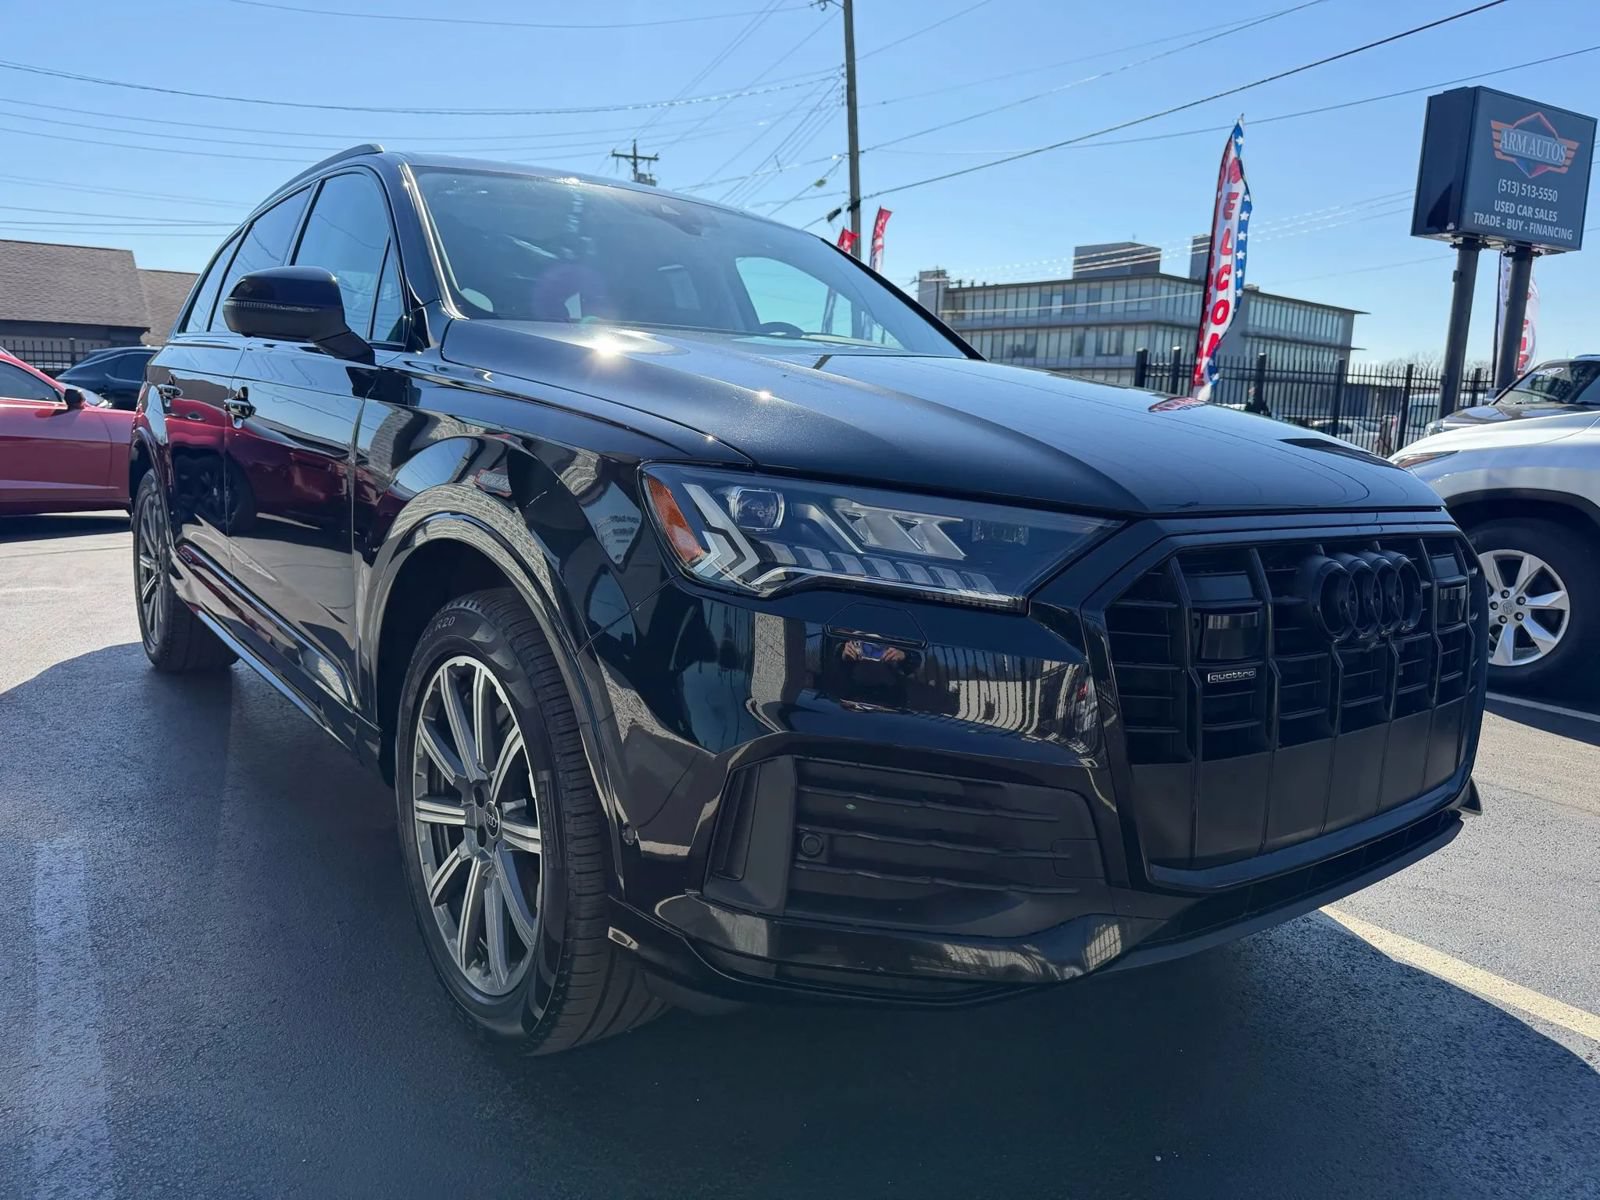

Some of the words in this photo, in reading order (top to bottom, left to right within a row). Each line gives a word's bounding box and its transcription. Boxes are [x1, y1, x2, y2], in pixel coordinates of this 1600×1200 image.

[1500, 130, 1527, 153] ARM
[1528, 137, 1567, 162] AUTOS
[1498, 179, 1520, 197] (513)
[1521, 184, 1558, 202] 513-5550
[1494, 200, 1516, 214] USED
[1517, 205, 1533, 219] CAR
[1534, 208, 1558, 222] SALES
[1473, 212, 1501, 228] TRADE
[1507, 218, 1525, 232] BUY
[1529, 222, 1573, 240] FINANCING
[1210, 670, 1255, 682] quattro
